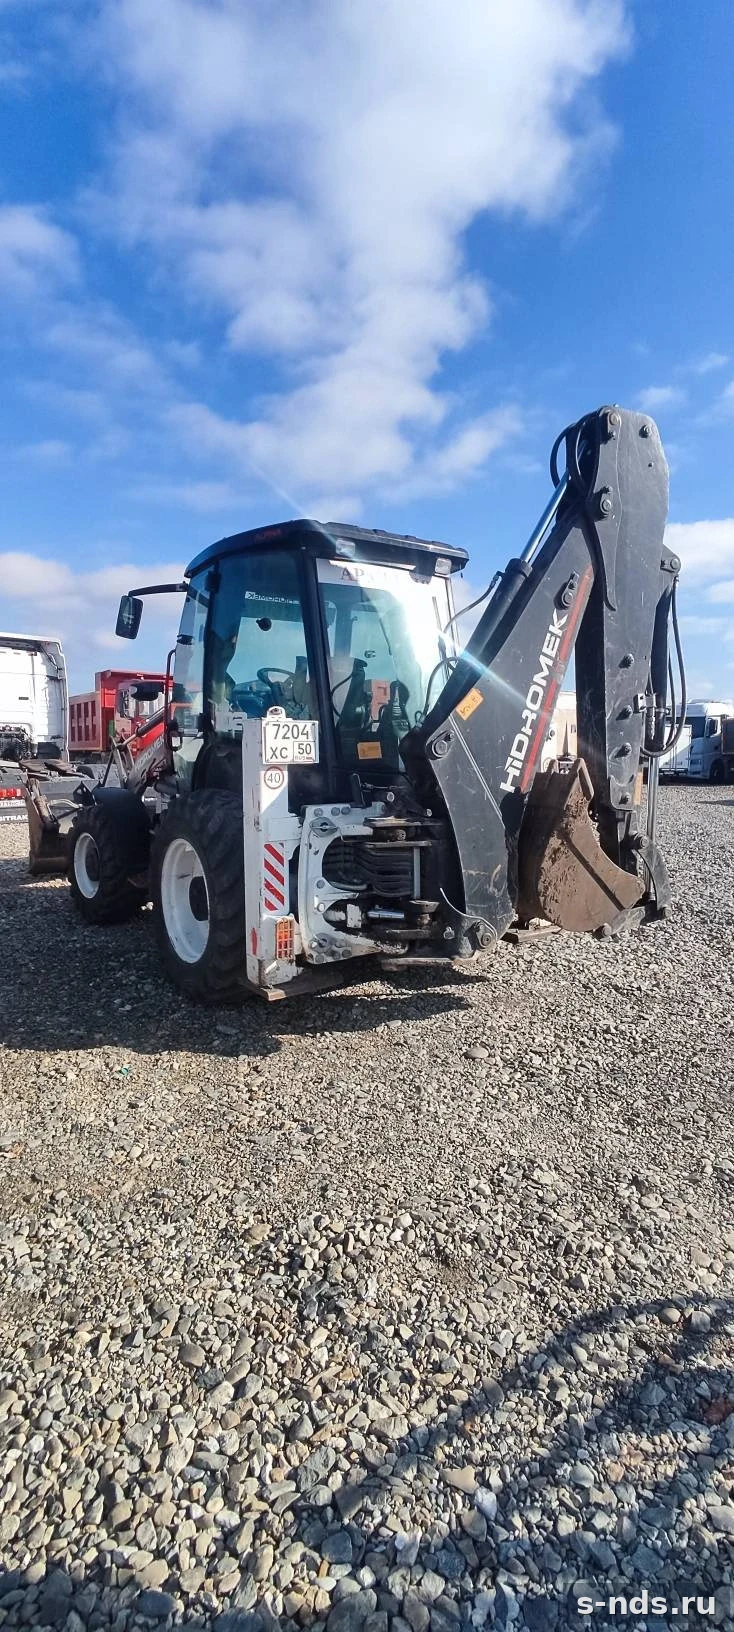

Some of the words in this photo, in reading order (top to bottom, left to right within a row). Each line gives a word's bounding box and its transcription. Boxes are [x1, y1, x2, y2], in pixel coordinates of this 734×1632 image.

[272, 723, 309, 740] 7204
[297, 743, 312, 755] 50
[267, 772, 281, 784] 40
